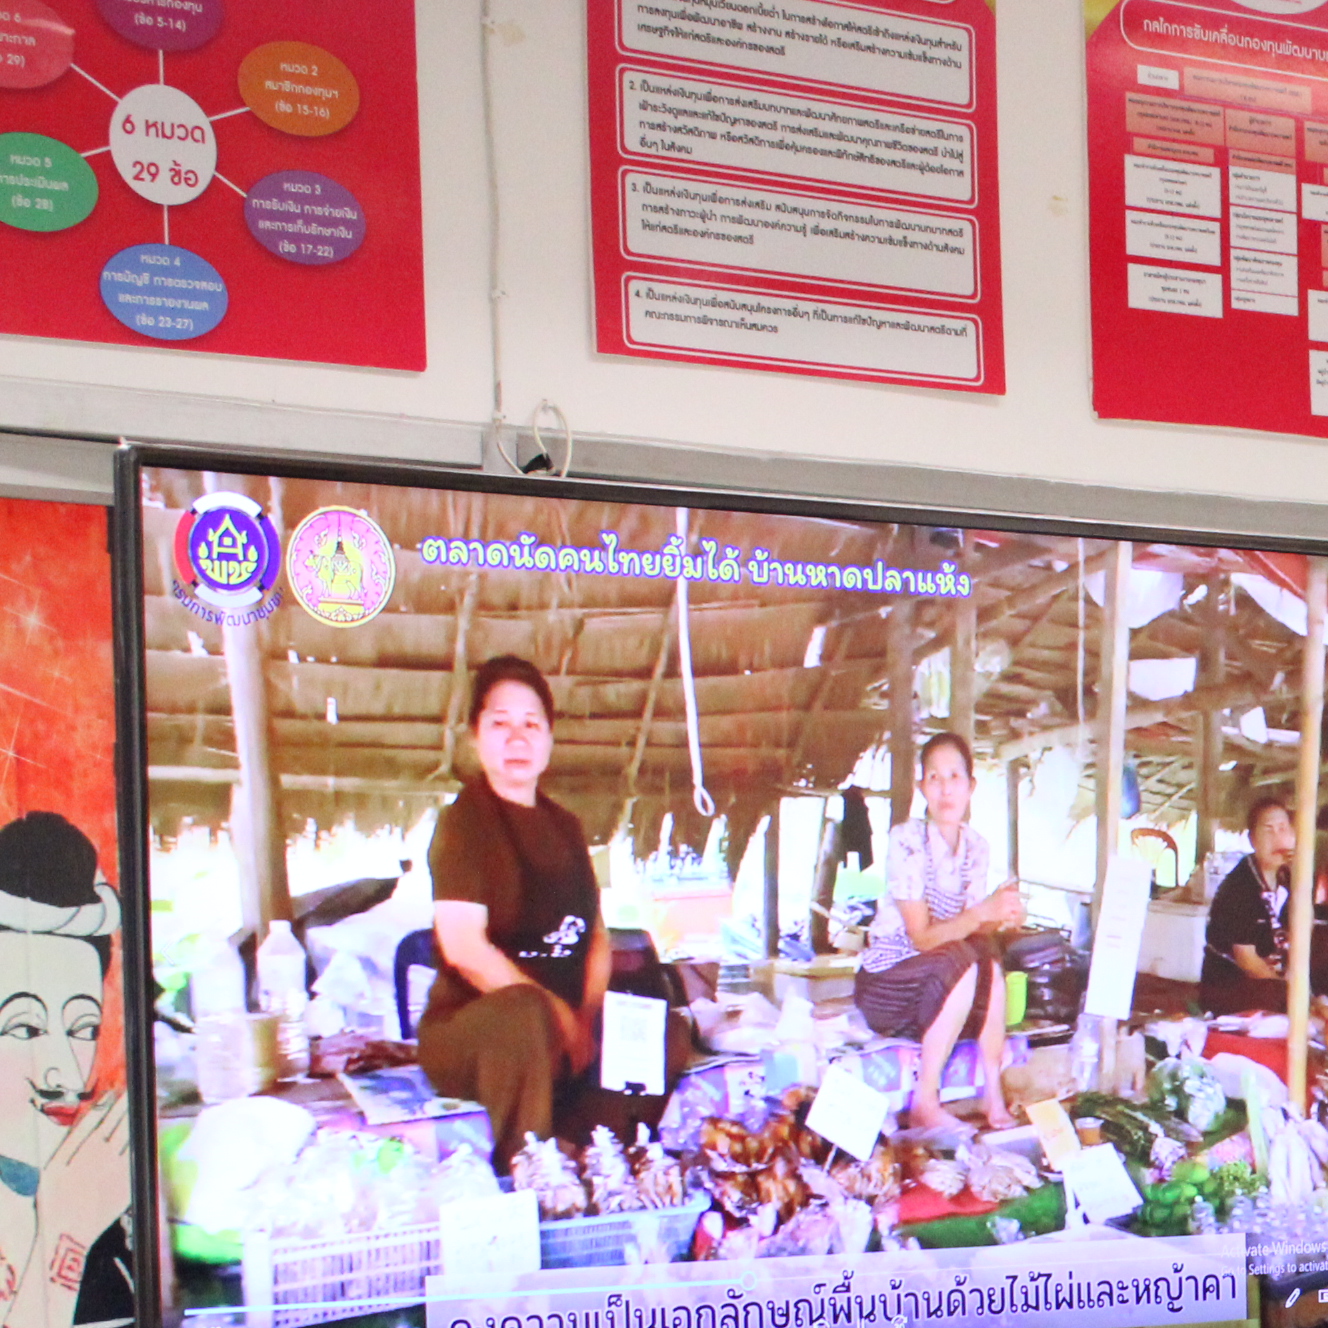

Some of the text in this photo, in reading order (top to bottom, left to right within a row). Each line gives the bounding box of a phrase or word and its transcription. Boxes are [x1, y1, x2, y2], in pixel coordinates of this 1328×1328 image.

[280, 61, 319, 76] หมวด 2
[296, 102, 330, 119] 15-16)
[121, 116, 206, 145] 6 หมวด
[131, 159, 200, 188] 29 ข้อ
[283, 179, 311, 195] หมวด
[300, 242, 334, 259] 17-22)
[172, 255, 181, 267] 4
[421, 530, 971, 597] ตลาดนัดคนไทยยิ้มได้ บ้านหาดปลาแห้ง
[1271, 1240, 1327, 1255] Windows
[1248, 1262, 1286, 1277] Settings
[1287, 1263, 1297, 1273] to
